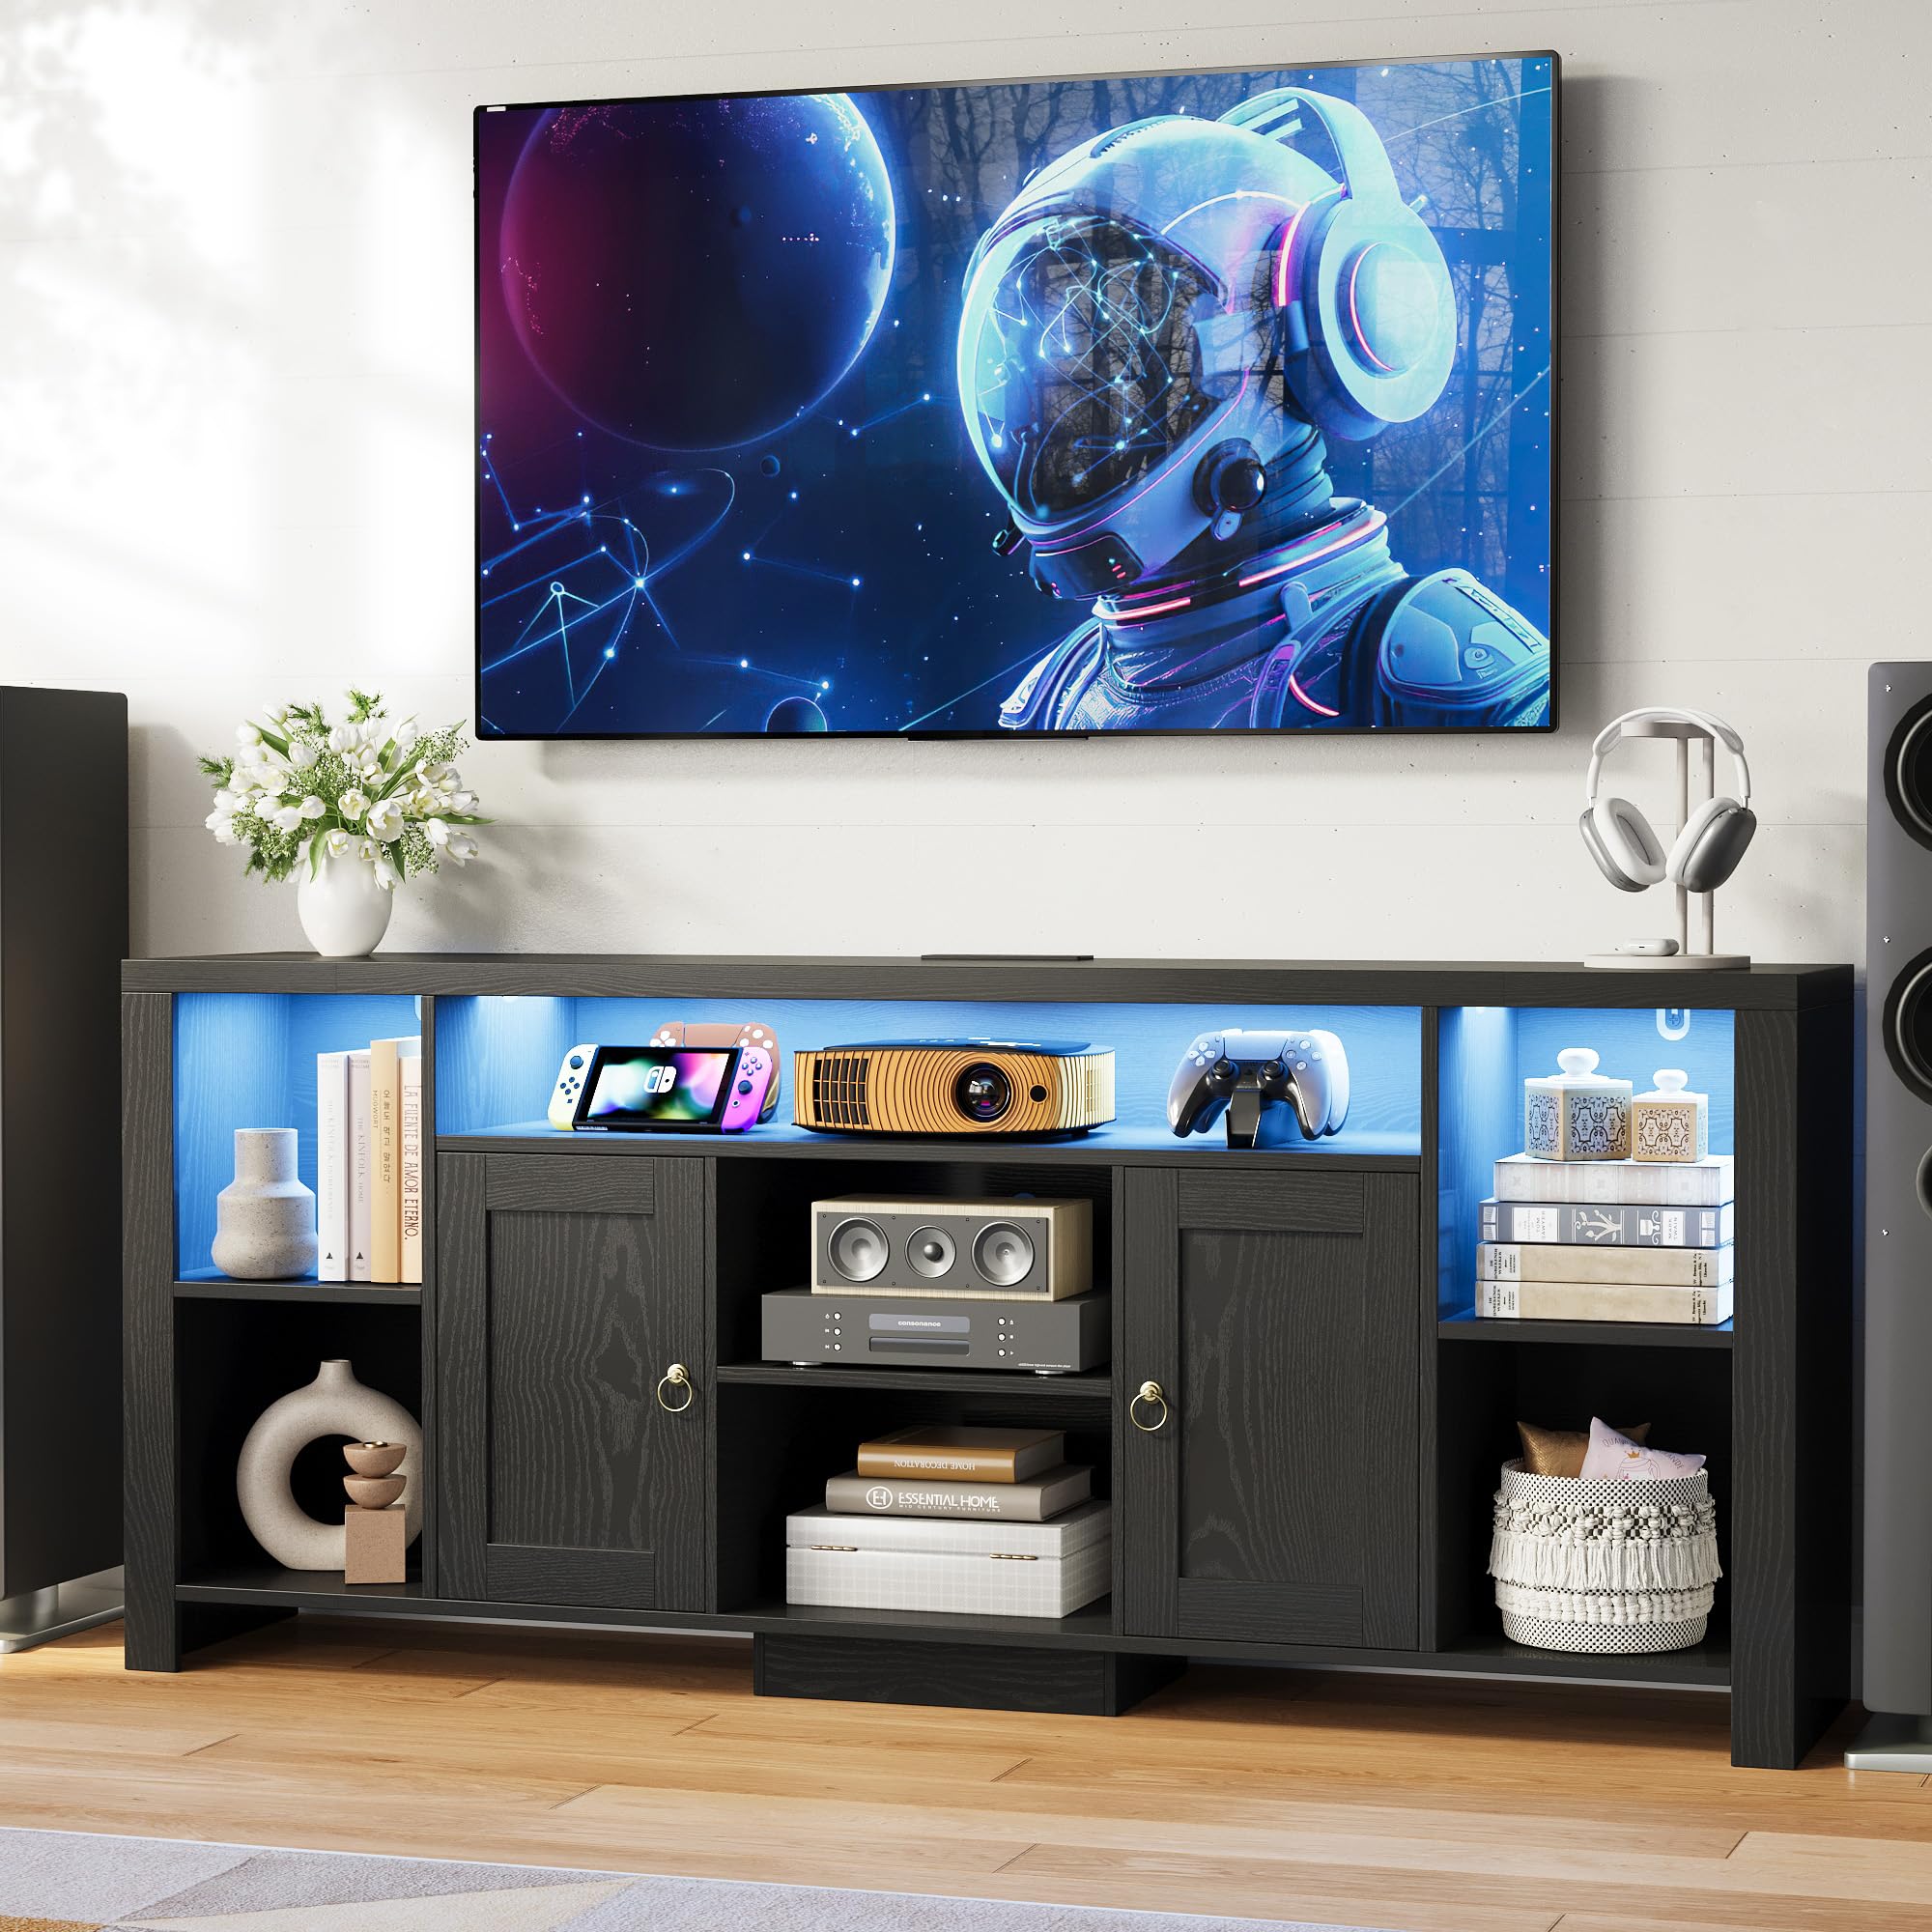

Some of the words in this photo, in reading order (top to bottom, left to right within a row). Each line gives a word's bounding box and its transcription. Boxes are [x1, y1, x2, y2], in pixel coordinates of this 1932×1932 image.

[404, 1085, 422, 1097] LA
[404, 1103, 418, 1139] FUENTE
[404, 1145, 419, 1157] DE
[404, 1162, 419, 1193] AMOR
[404, 1199, 419, 1240] ETERNO.
[894, 1460, 948, 1469] DECORATION
[950, 1461, 976, 1471] HOME
[898, 1492, 958, 1507] ESSENTIAL
[960, 1494, 1000, 1509] HOME
